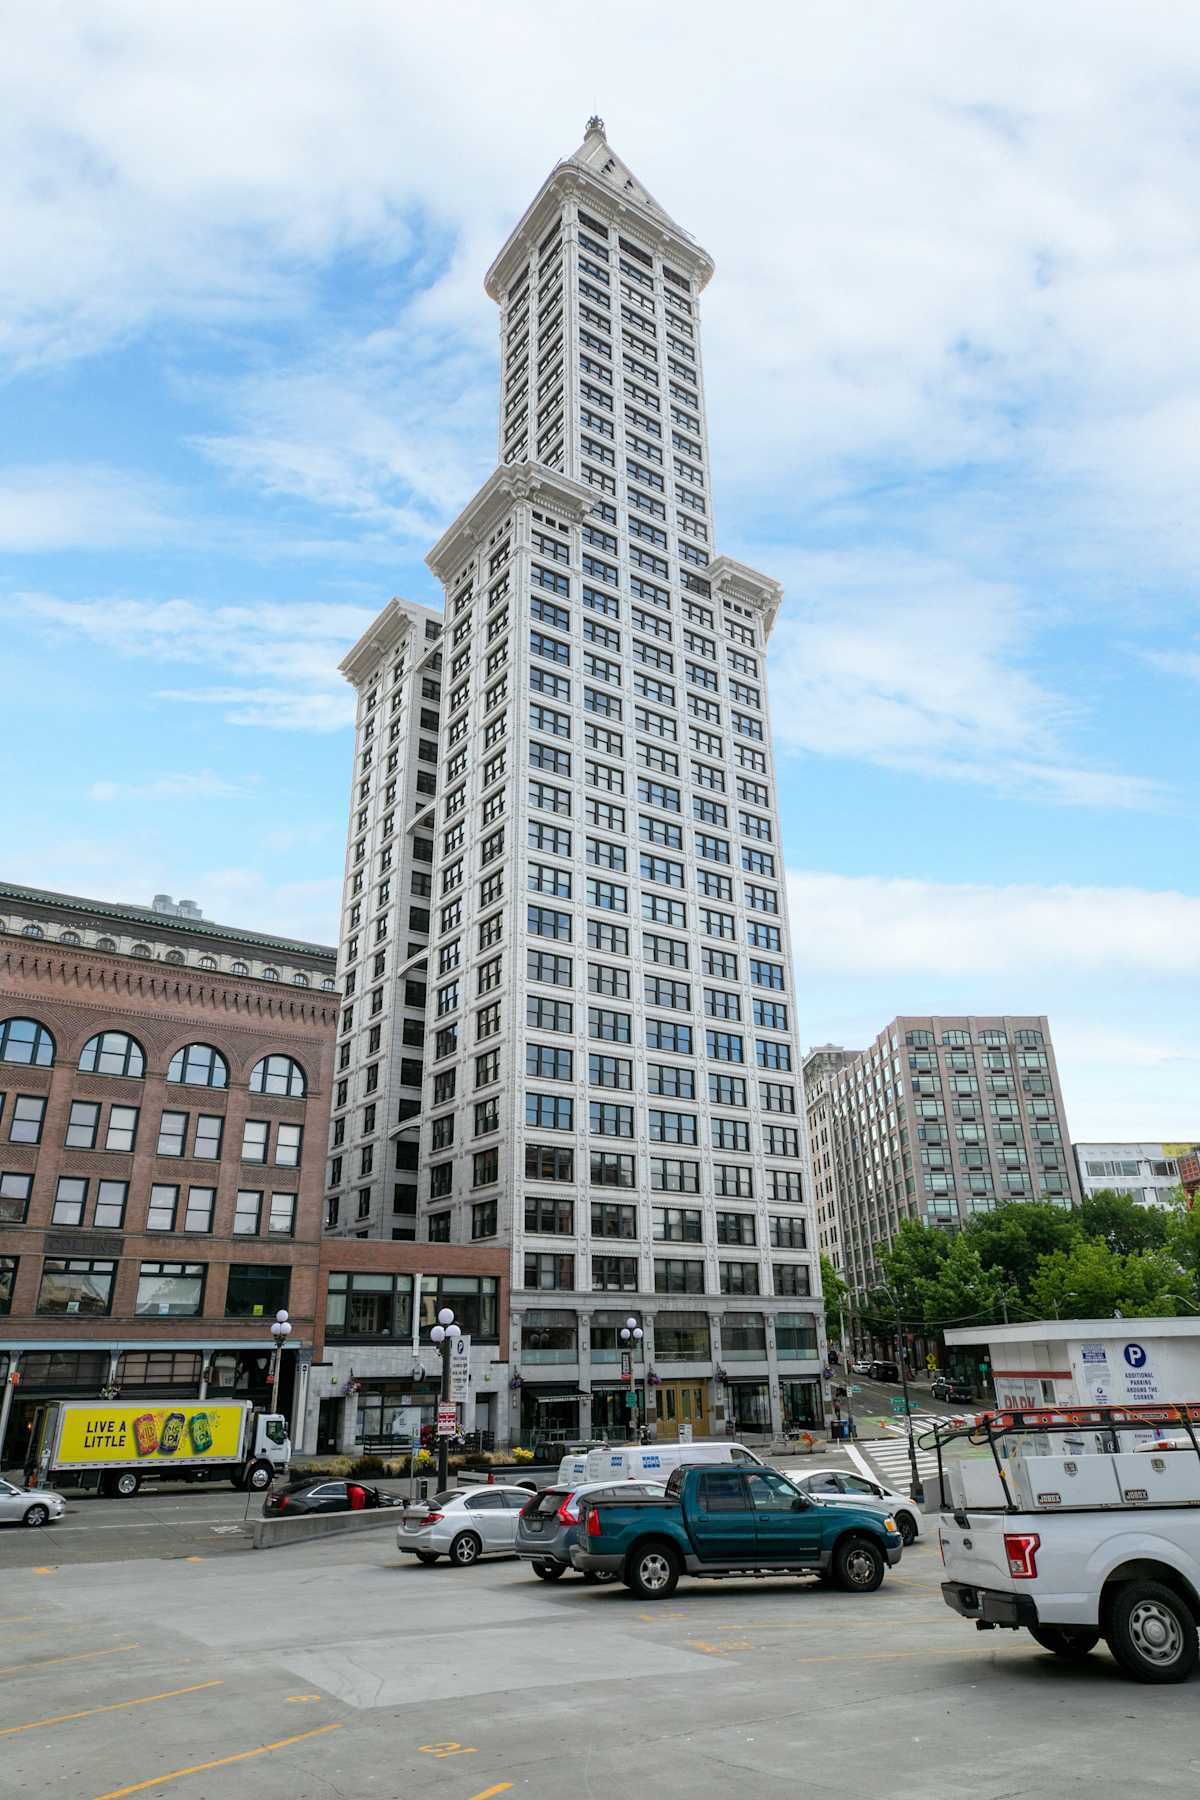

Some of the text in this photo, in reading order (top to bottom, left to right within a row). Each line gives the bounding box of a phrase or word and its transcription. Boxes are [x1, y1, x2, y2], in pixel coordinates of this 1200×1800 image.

[1133, 1393, 1154, 1401] CORNER
[86, 1421, 127, 1433] LIVE A
[84, 1435, 126, 1448] LITTLE
